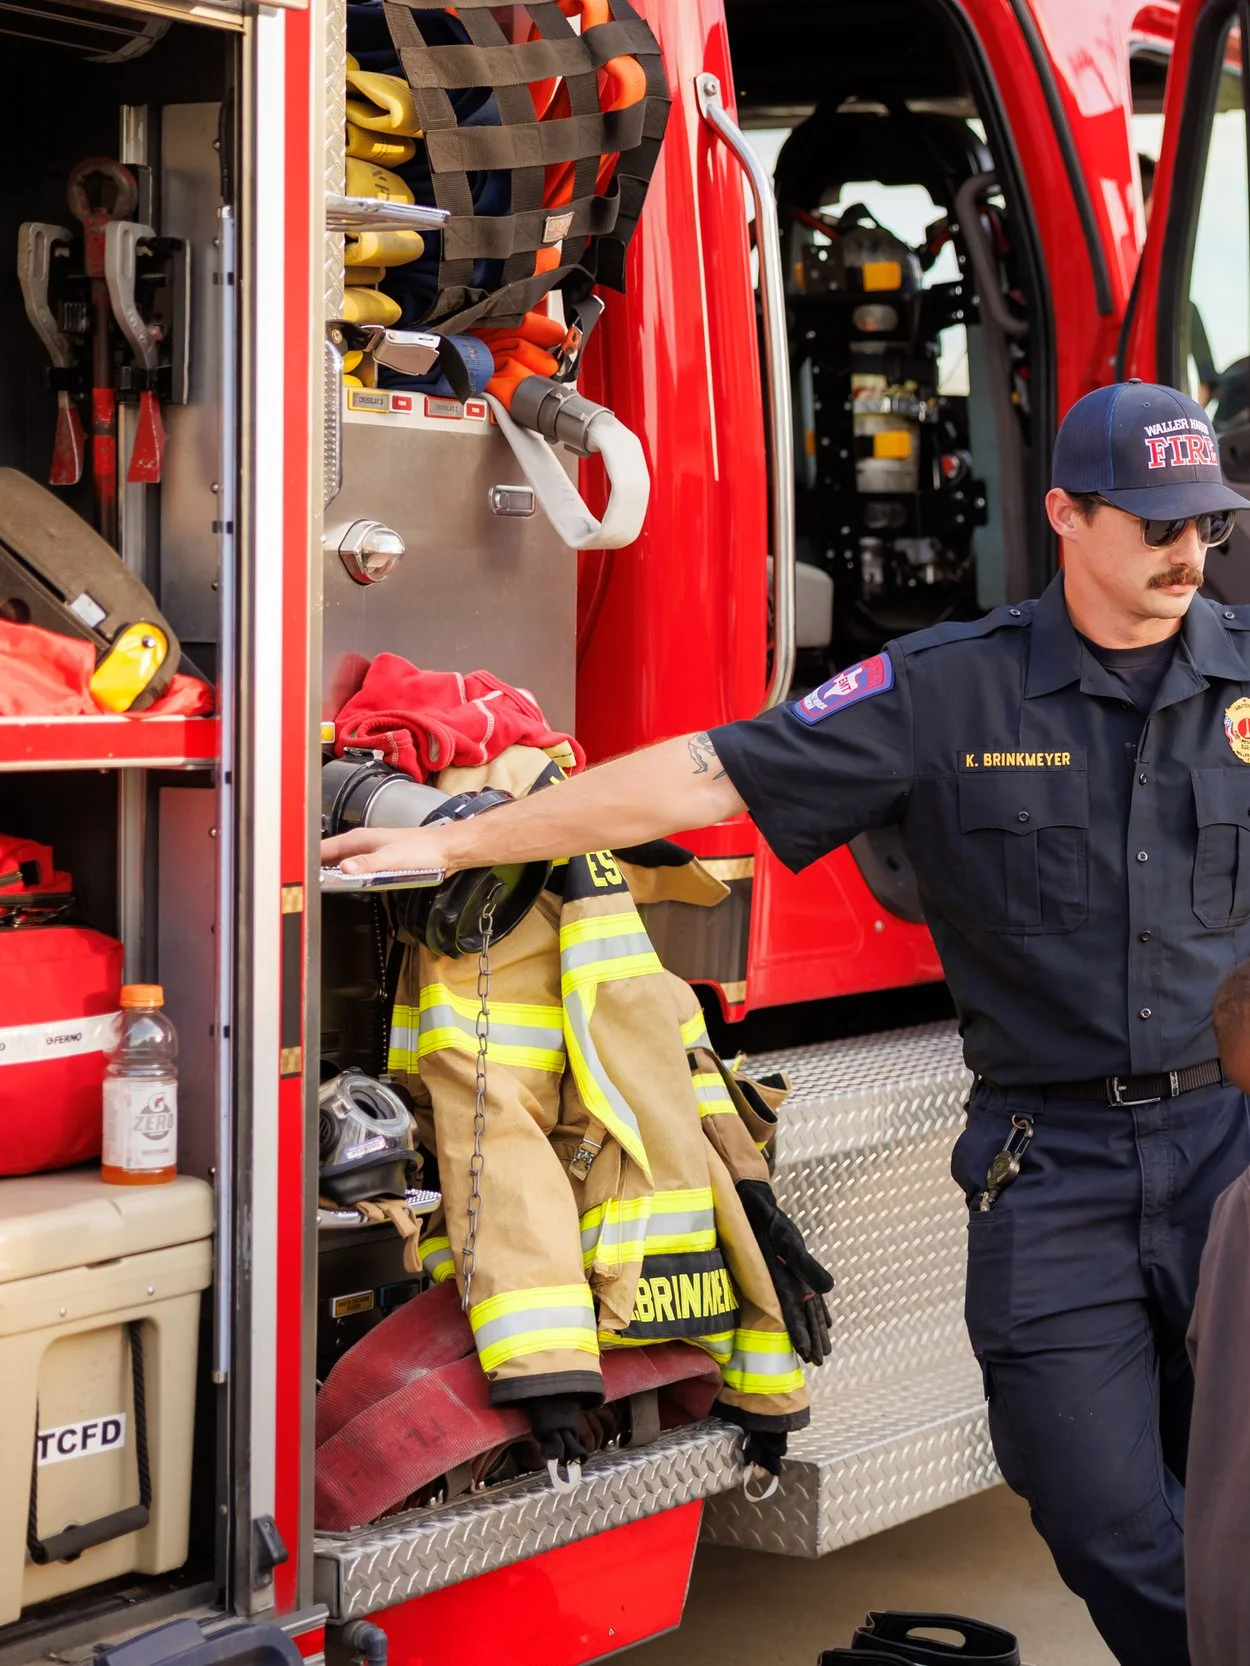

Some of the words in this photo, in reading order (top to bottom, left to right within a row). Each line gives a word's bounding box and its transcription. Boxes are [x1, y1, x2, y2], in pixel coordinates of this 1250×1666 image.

[1144, 418, 1189, 437] WALLER
[1144, 434, 1219, 470] FIRE
[965, 753, 979, 767] K.
[983, 752, 1071, 767] BRINKMEYER
[132, 1112, 174, 1132] ZERO
[36, 1419, 122, 1460] TCFD
